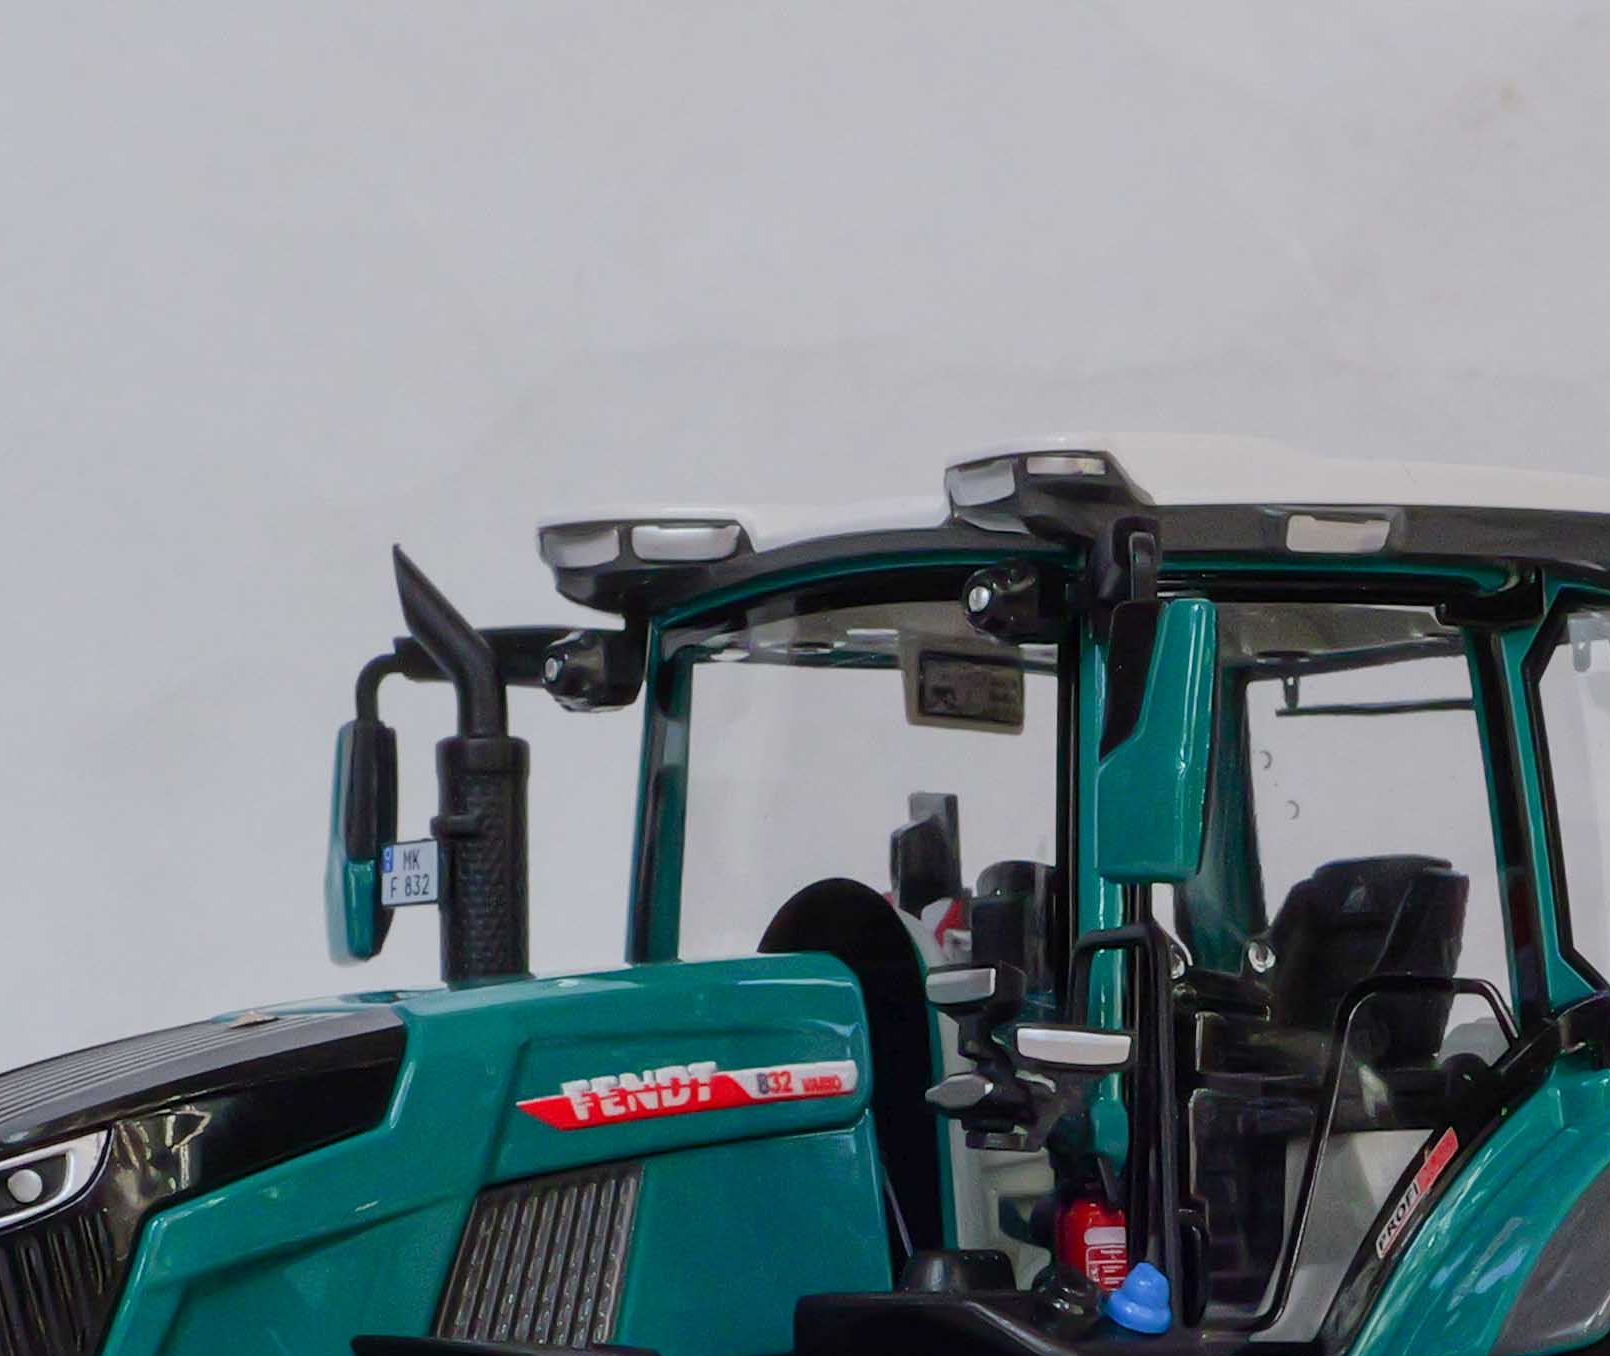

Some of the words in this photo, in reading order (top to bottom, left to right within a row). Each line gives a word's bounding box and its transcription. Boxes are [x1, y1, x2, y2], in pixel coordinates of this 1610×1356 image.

[390, 876, 398, 898] F
[405, 873, 430, 897] 832
[561, 1060, 717, 1121] FENDT
[756, 1070, 793, 1095] 832
